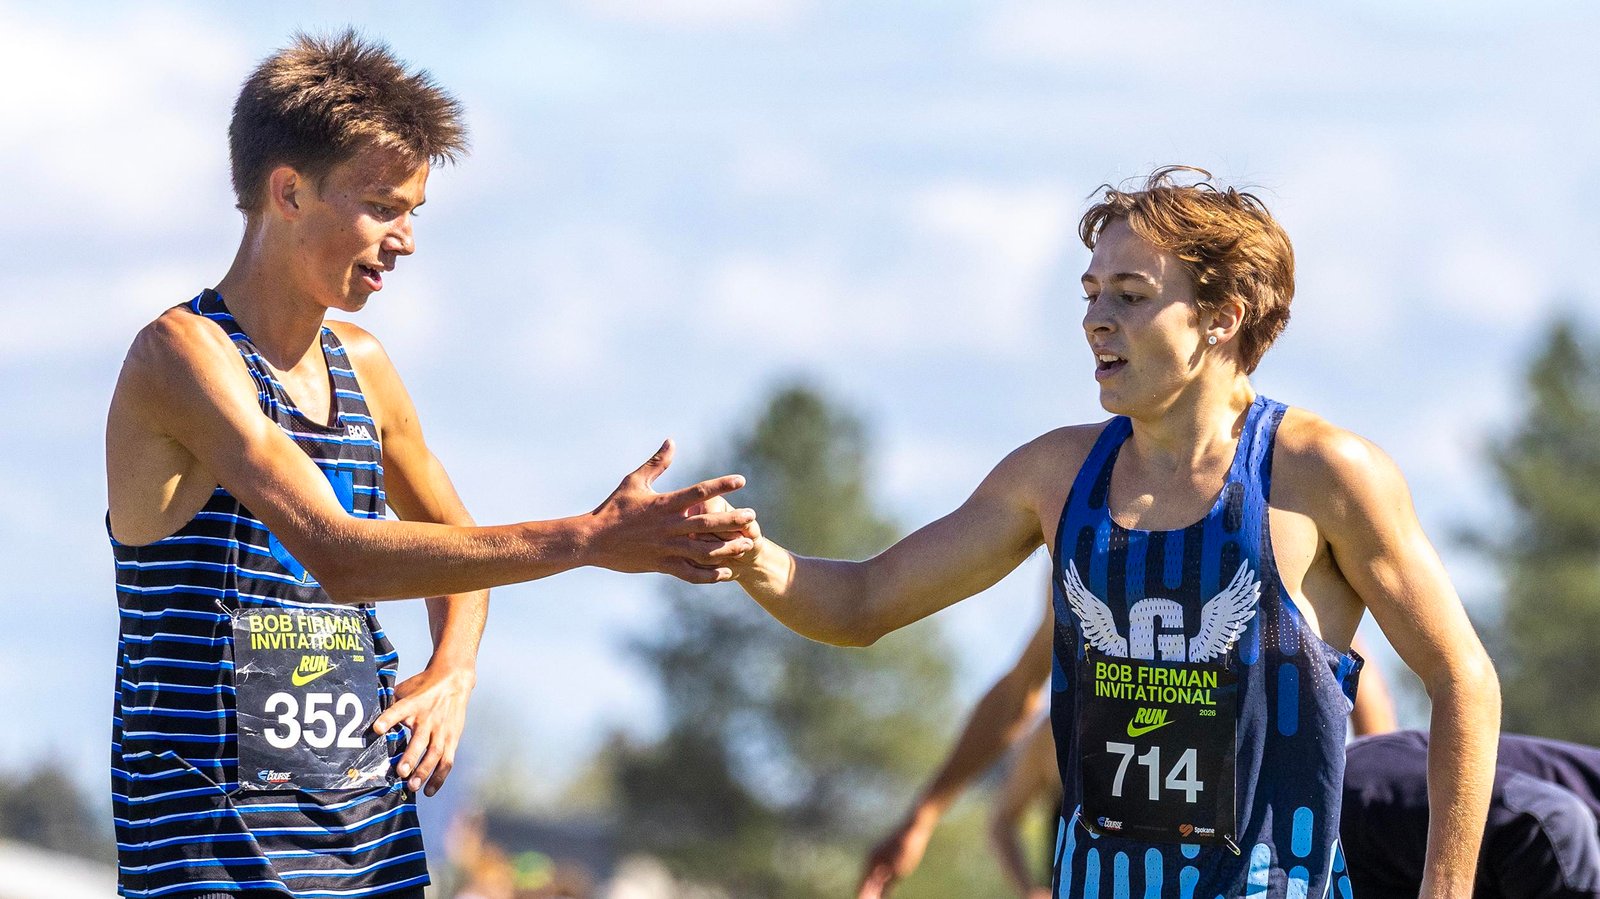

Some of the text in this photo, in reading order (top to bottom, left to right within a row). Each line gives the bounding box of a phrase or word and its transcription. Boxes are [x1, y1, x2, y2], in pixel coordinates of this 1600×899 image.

[249, 615, 362, 634] BOB FIRMAN
[251, 633, 364, 651] INVITATIONAL
[299, 655, 329, 672] RUN
[1096, 662, 1218, 688] BOB FIRMAN
[1095, 680, 1217, 706] INVITATIONAL
[263, 692, 366, 749] 352
[1134, 707, 1168, 725] RUN
[1199, 709, 1216, 717] 2026
[266, 772, 292, 780] COURSE
[1106, 741, 1204, 803] 714
[1104, 820, 1123, 829] COURSE
[1194, 826, 1215, 834] Spokane
